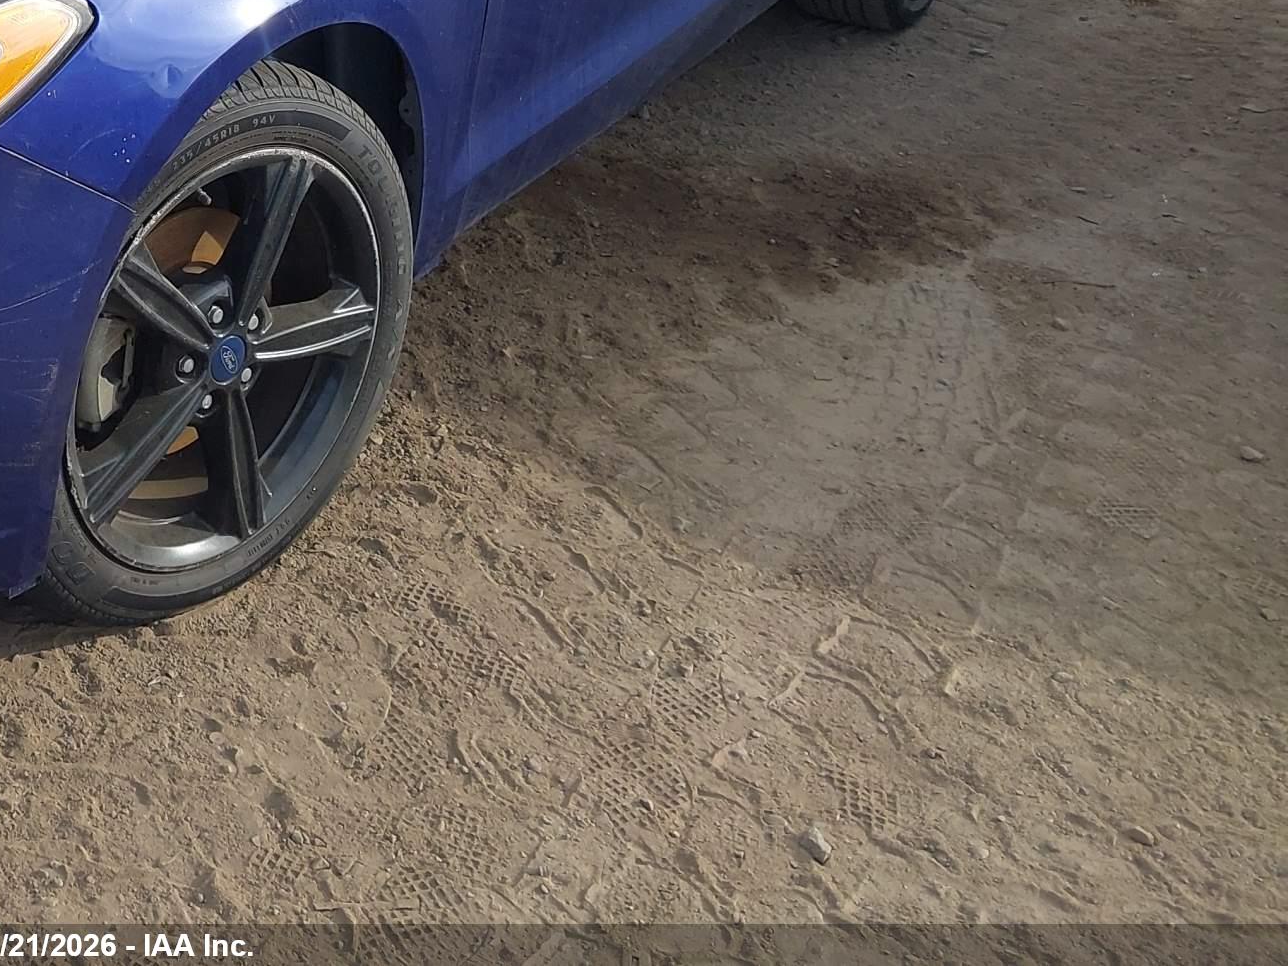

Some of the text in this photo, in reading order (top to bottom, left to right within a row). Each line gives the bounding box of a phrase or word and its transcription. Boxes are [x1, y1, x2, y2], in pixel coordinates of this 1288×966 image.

[171, 114, 276, 172] 235/45R18 94V
[222, 350, 235, 370] Ford
